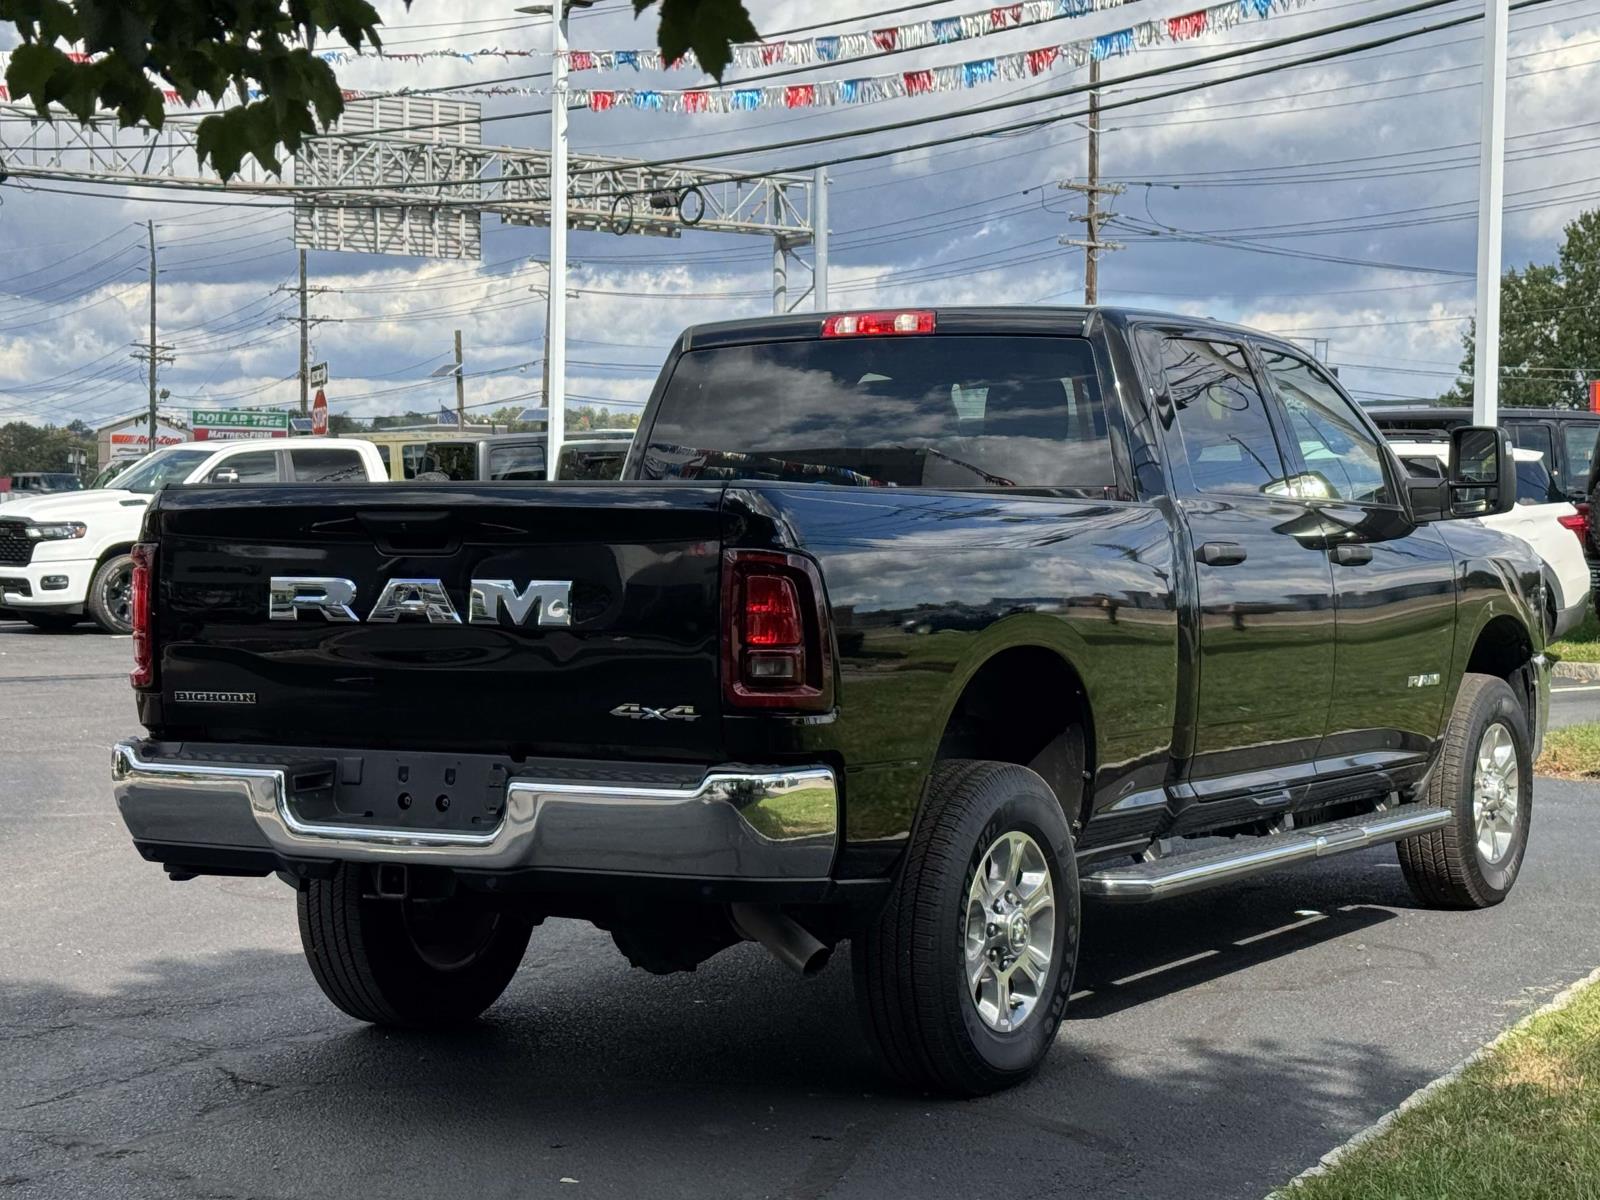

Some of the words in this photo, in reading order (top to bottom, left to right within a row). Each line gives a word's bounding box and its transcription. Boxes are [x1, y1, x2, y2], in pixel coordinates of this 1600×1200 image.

[196, 412, 248, 425] DOLLAR
[251, 414, 283, 426] TREE
[269, 576, 573, 626] RAM
[1408, 673, 1440, 688] RAM
[174, 690, 257, 704] BIGHORN
